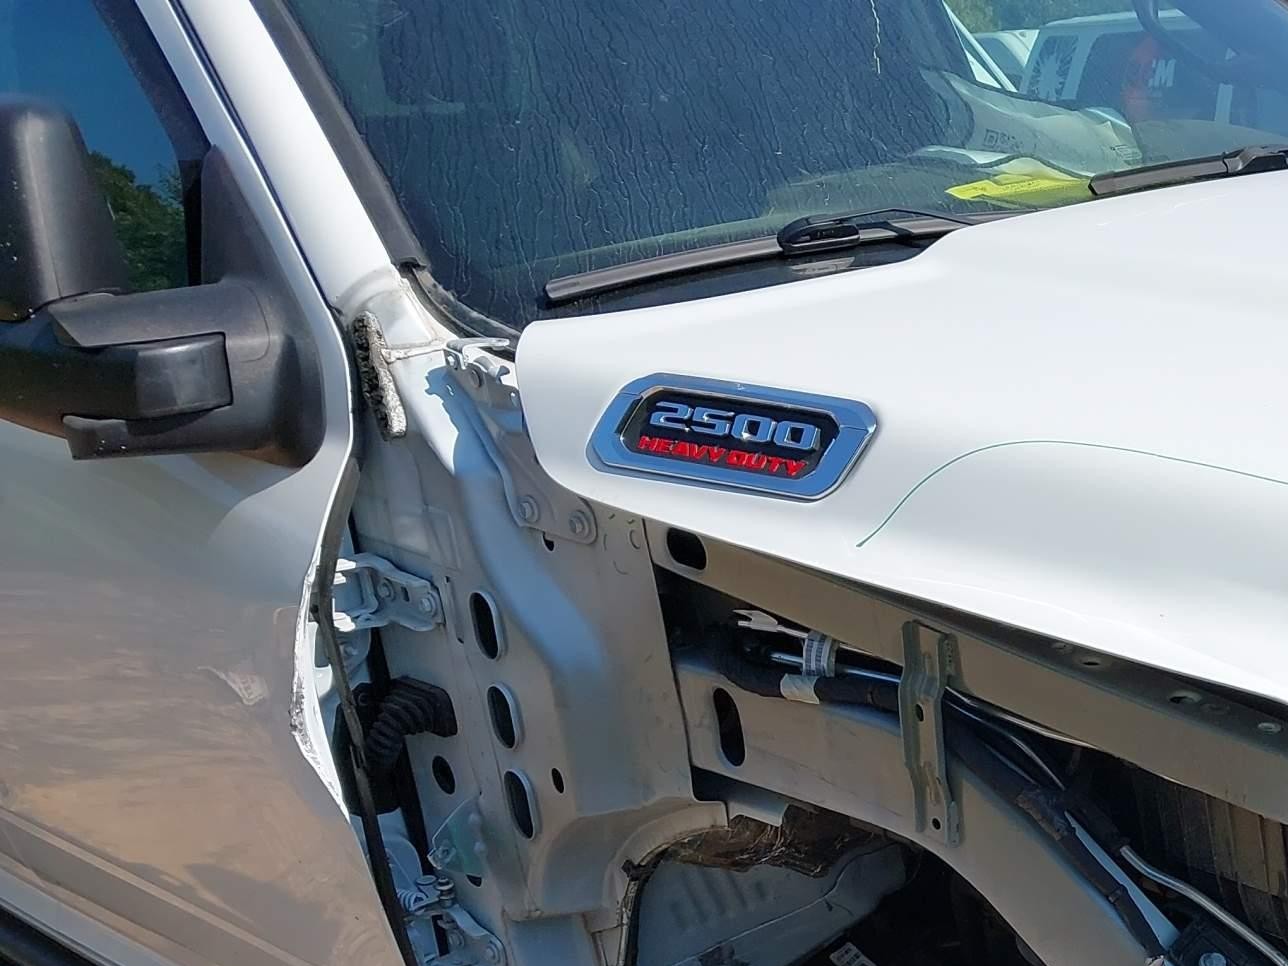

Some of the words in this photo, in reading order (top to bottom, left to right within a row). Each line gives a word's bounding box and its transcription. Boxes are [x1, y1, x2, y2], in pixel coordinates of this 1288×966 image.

[650, 401, 820, 449] 2500
[637, 435, 726, 462] HEAVY
[725, 449, 806, 475] DUTY
